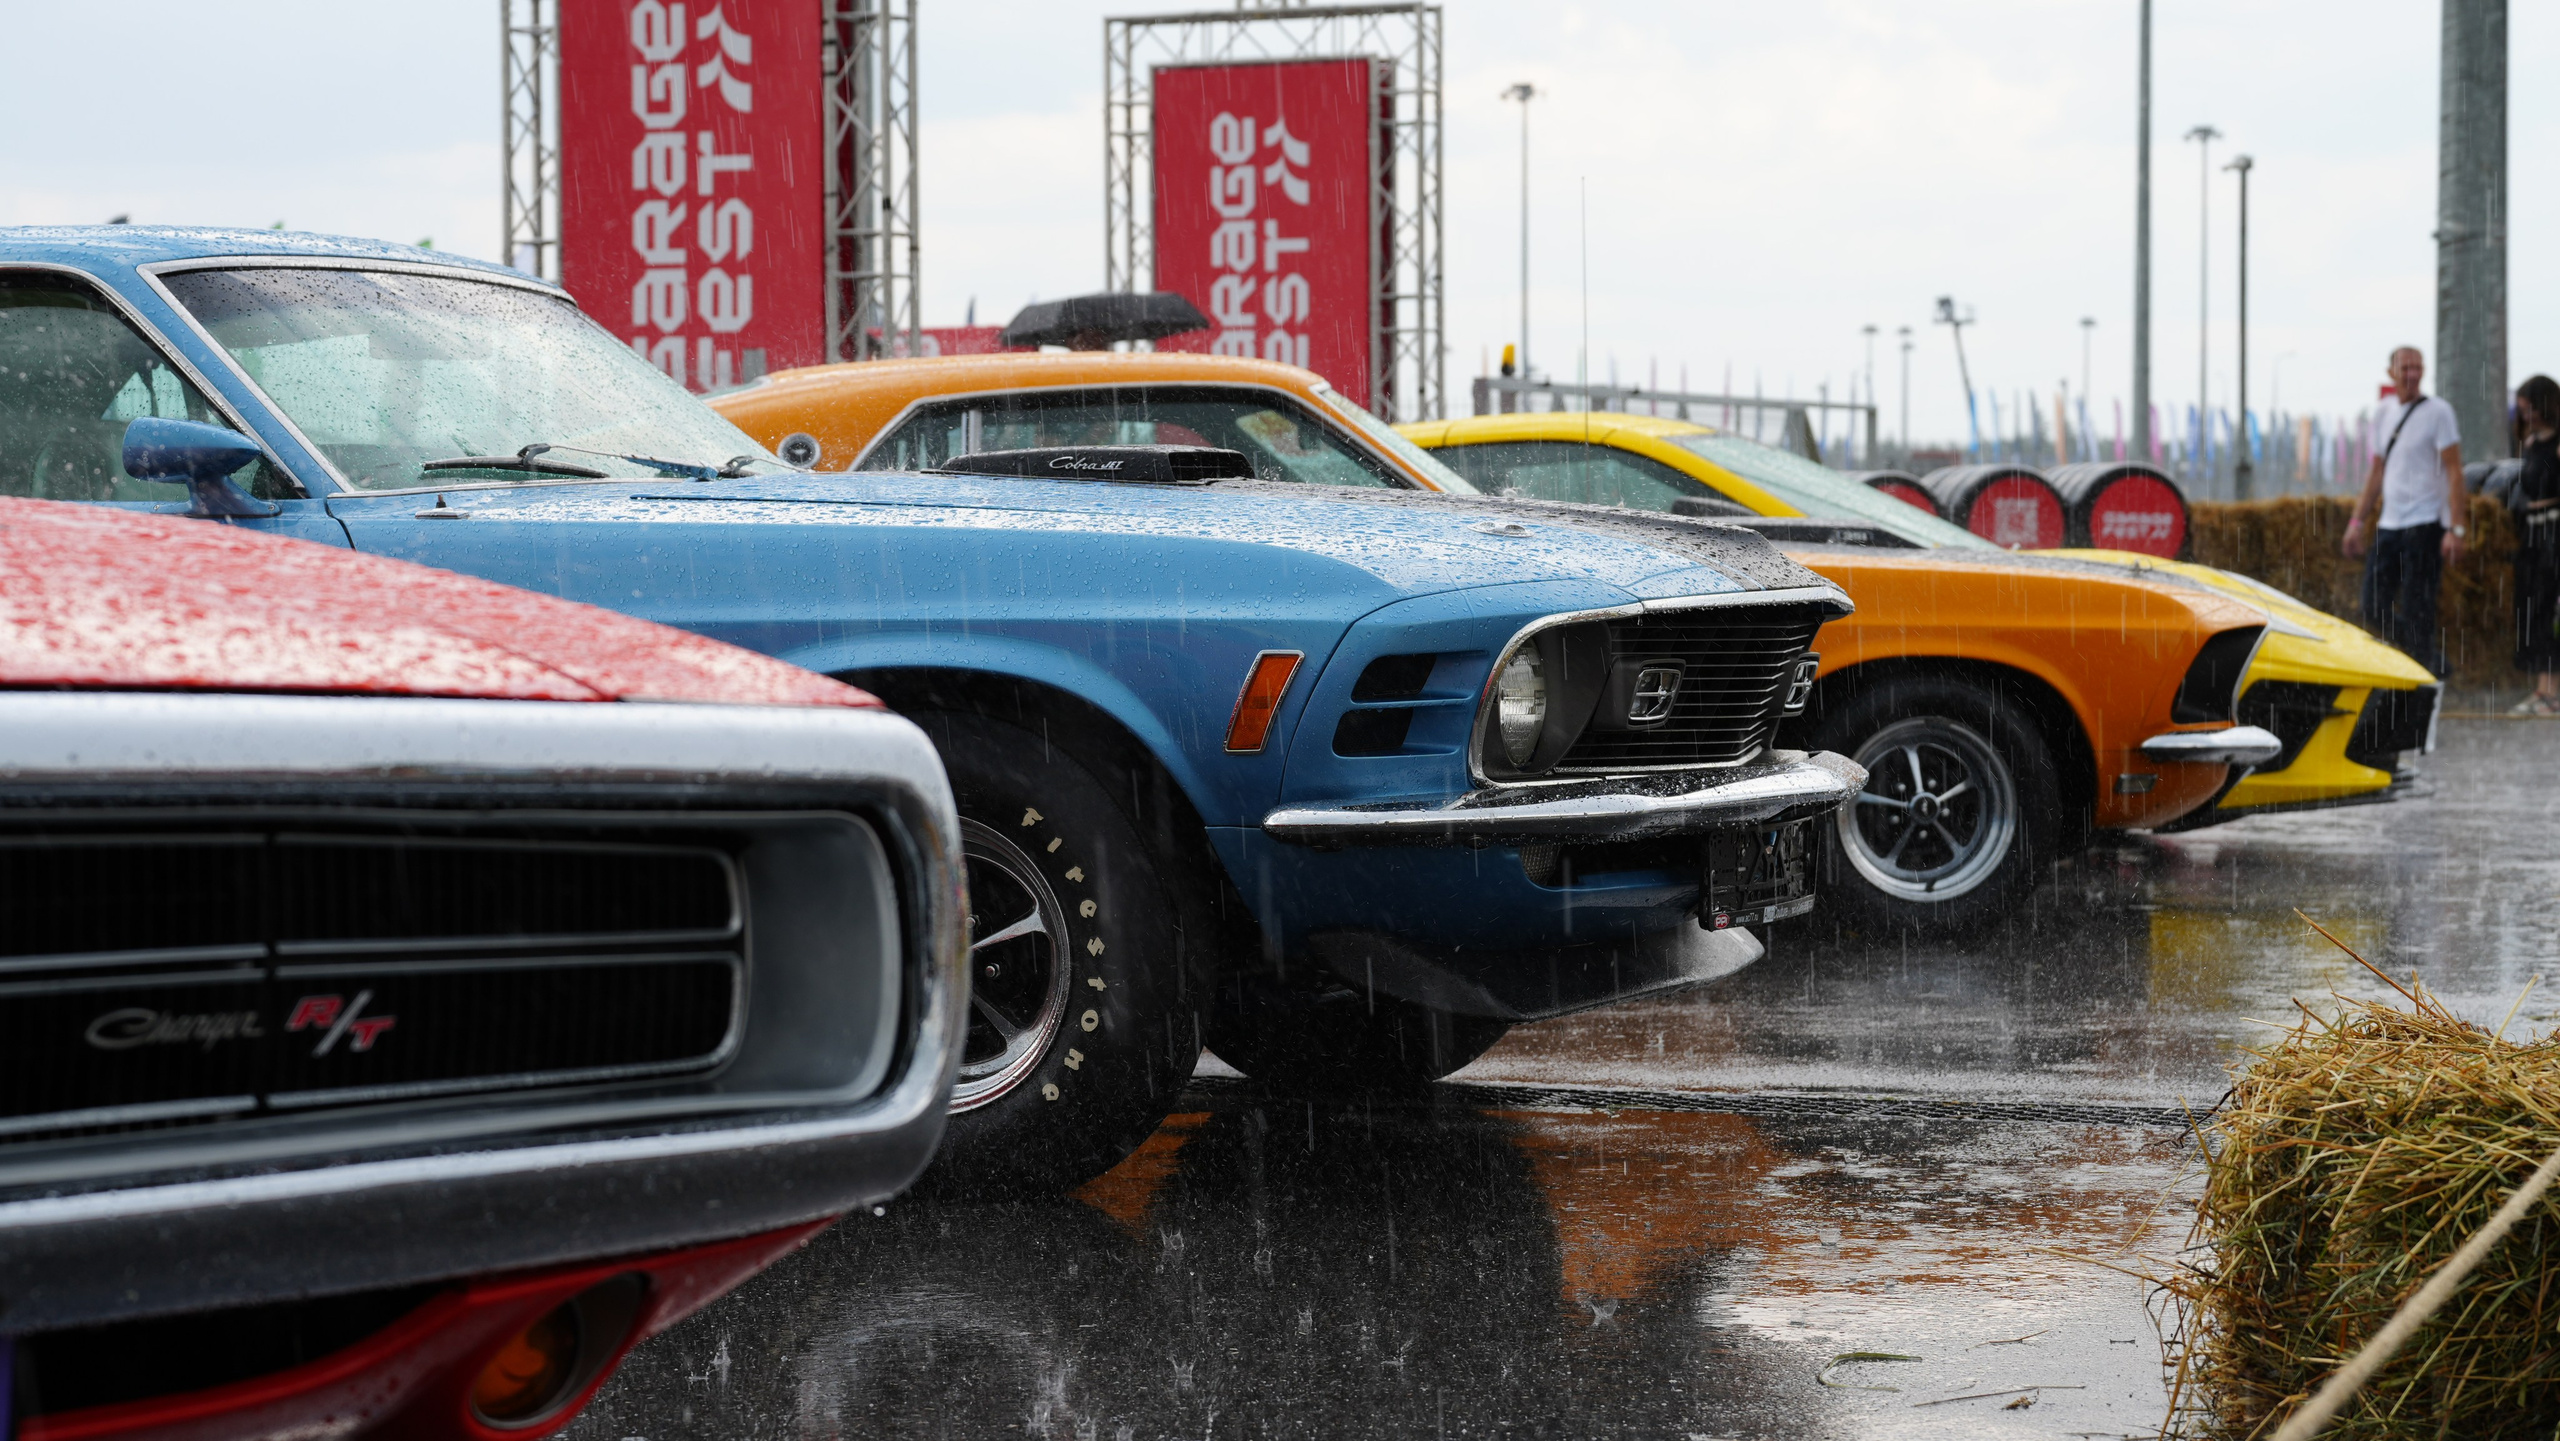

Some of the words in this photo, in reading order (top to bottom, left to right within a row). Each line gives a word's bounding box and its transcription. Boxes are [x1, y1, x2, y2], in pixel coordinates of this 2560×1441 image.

[1049, 456, 1099, 470] Cobra
[1101, 461, 1124, 470] JET
[285, 989, 396, 1057] R/T
